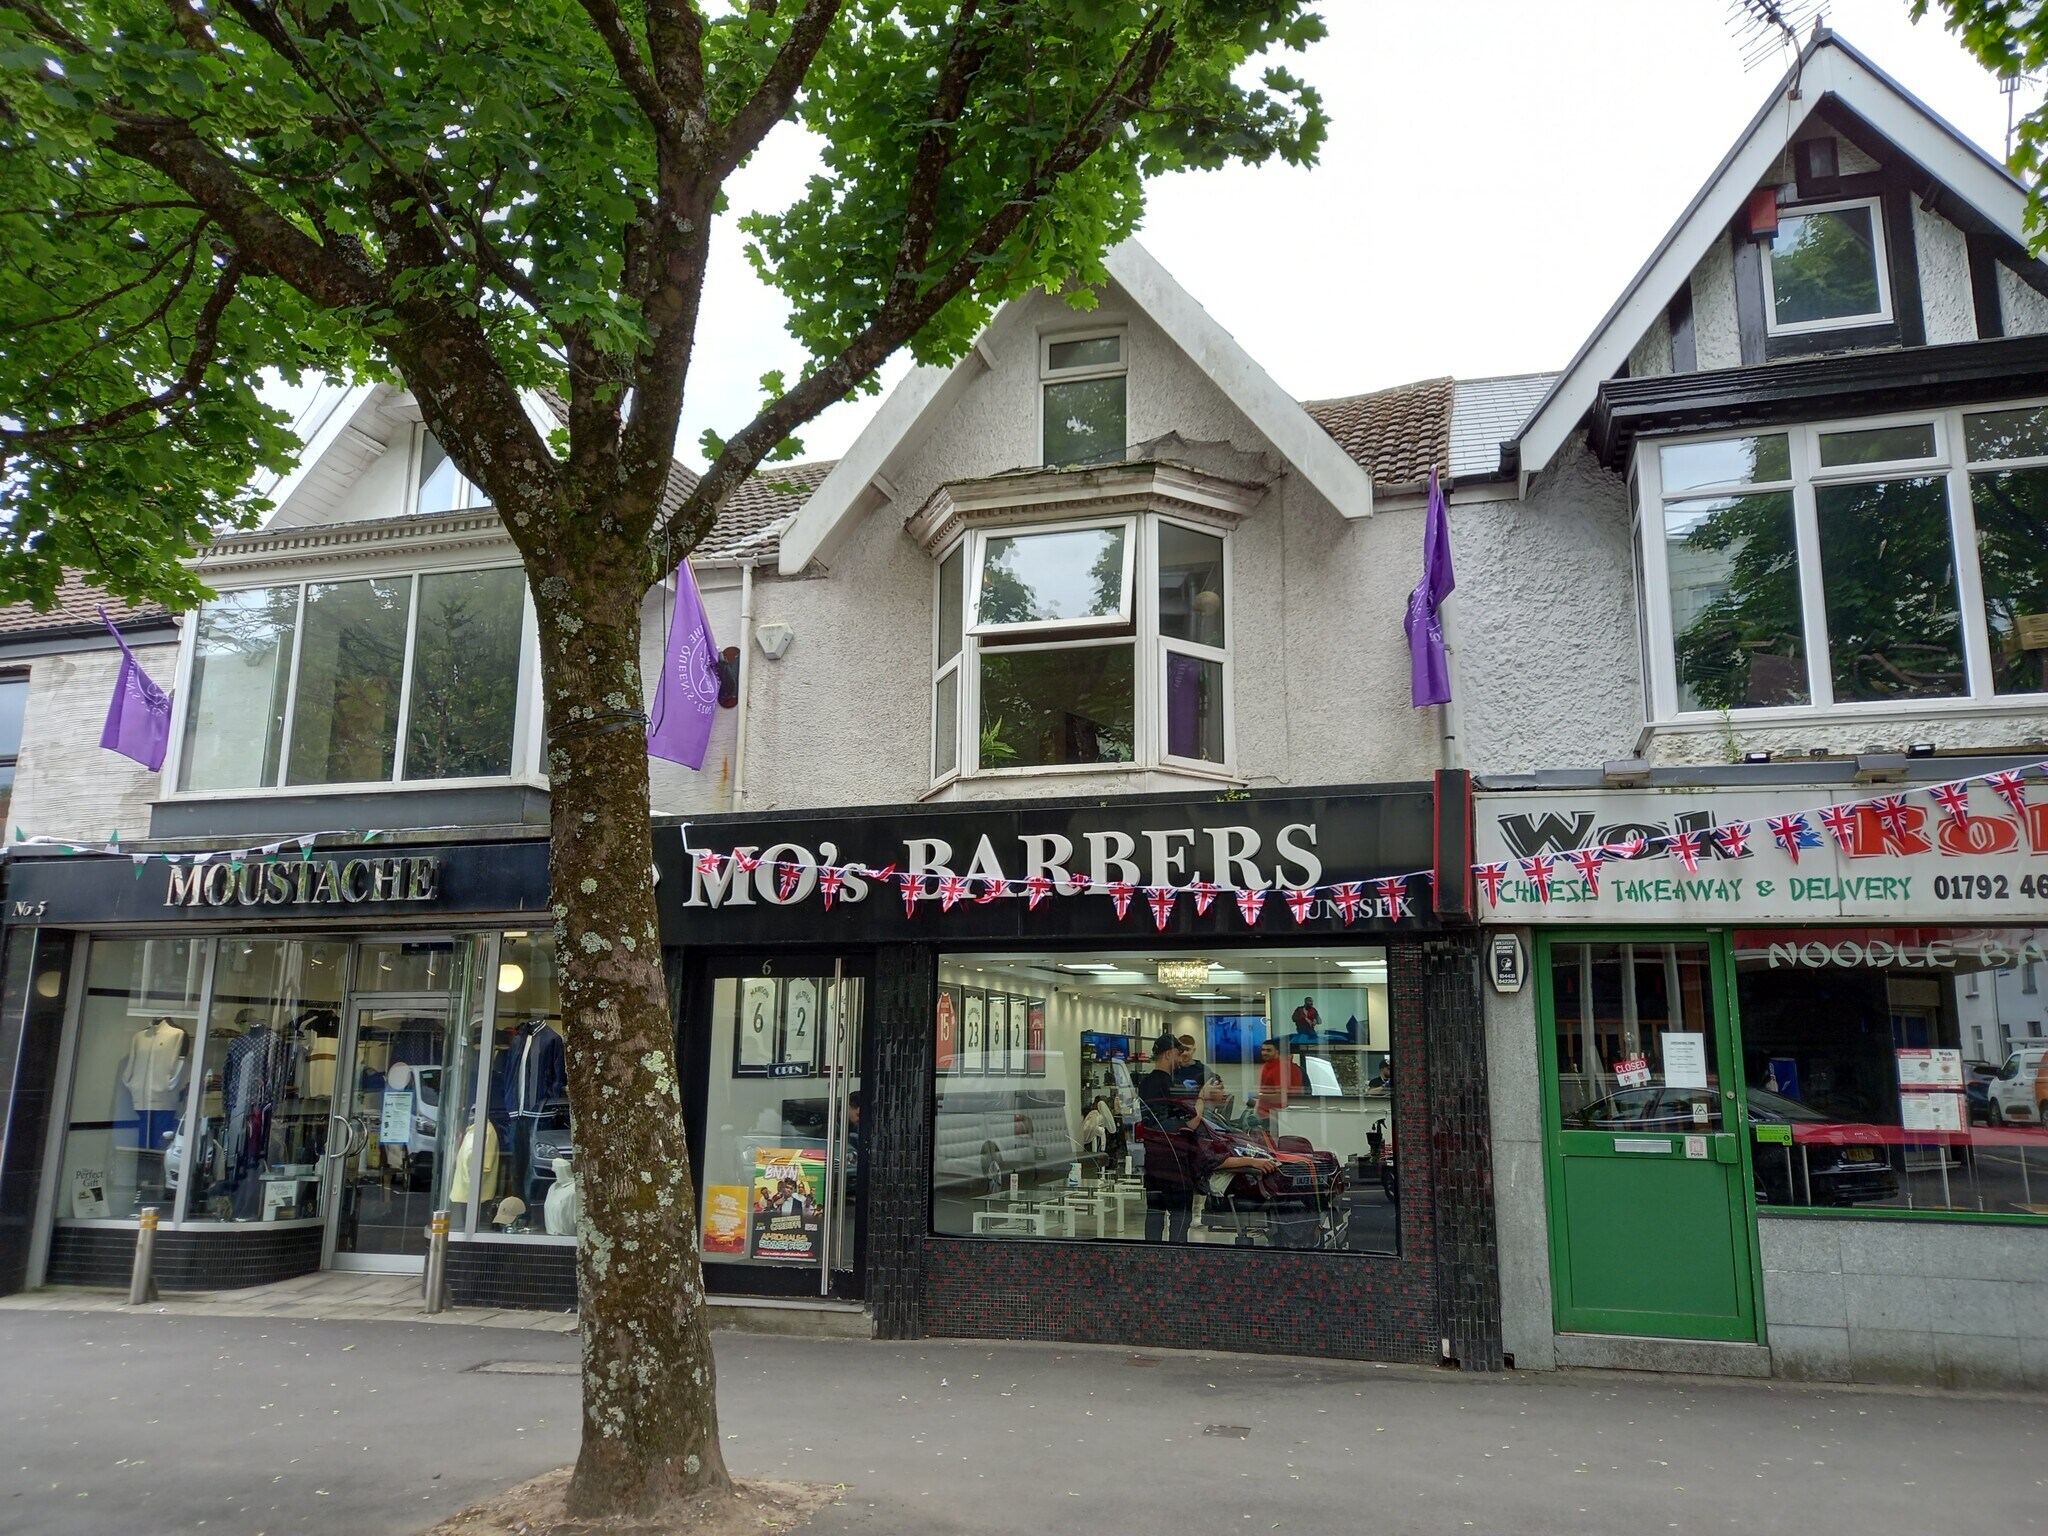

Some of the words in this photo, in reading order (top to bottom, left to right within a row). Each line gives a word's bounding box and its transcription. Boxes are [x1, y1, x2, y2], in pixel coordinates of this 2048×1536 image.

[683, 842, 869, 909] MO's
[902, 823, 1323, 901] BARBERS
[163, 857, 439, 907] MOUSTACHE
[1611, 877, 1743, 903] TAKEAWAY
[1756, 879, 1776, 898] &
[1790, 876, 1912, 902] DELIVERY
[1934, 874, 2009, 900] 01792
[12, 901, 32, 917] No
[36, 901, 48, 917] 5
[1306, 897, 1416, 920] UNSEX
[1768, 939, 1957, 969] NOODLE
[762, 958, 774, 975] 6
[753, 1002, 764, 1034] 6
[796, 1006, 806, 1037] 2
[940, 1012, 950, 1042] 15
[968, 1021, 979, 1048] 23
[774, 1065, 803, 1076] OPEN
[1615, 1059, 1646, 1075] CLOSED
[1675, 1141, 1684, 1154] 7
[75, 1168, 104, 1180] Perfect
[82, 1179, 99, 1188] Gift
[764, 1164, 799, 1182] BNXN
